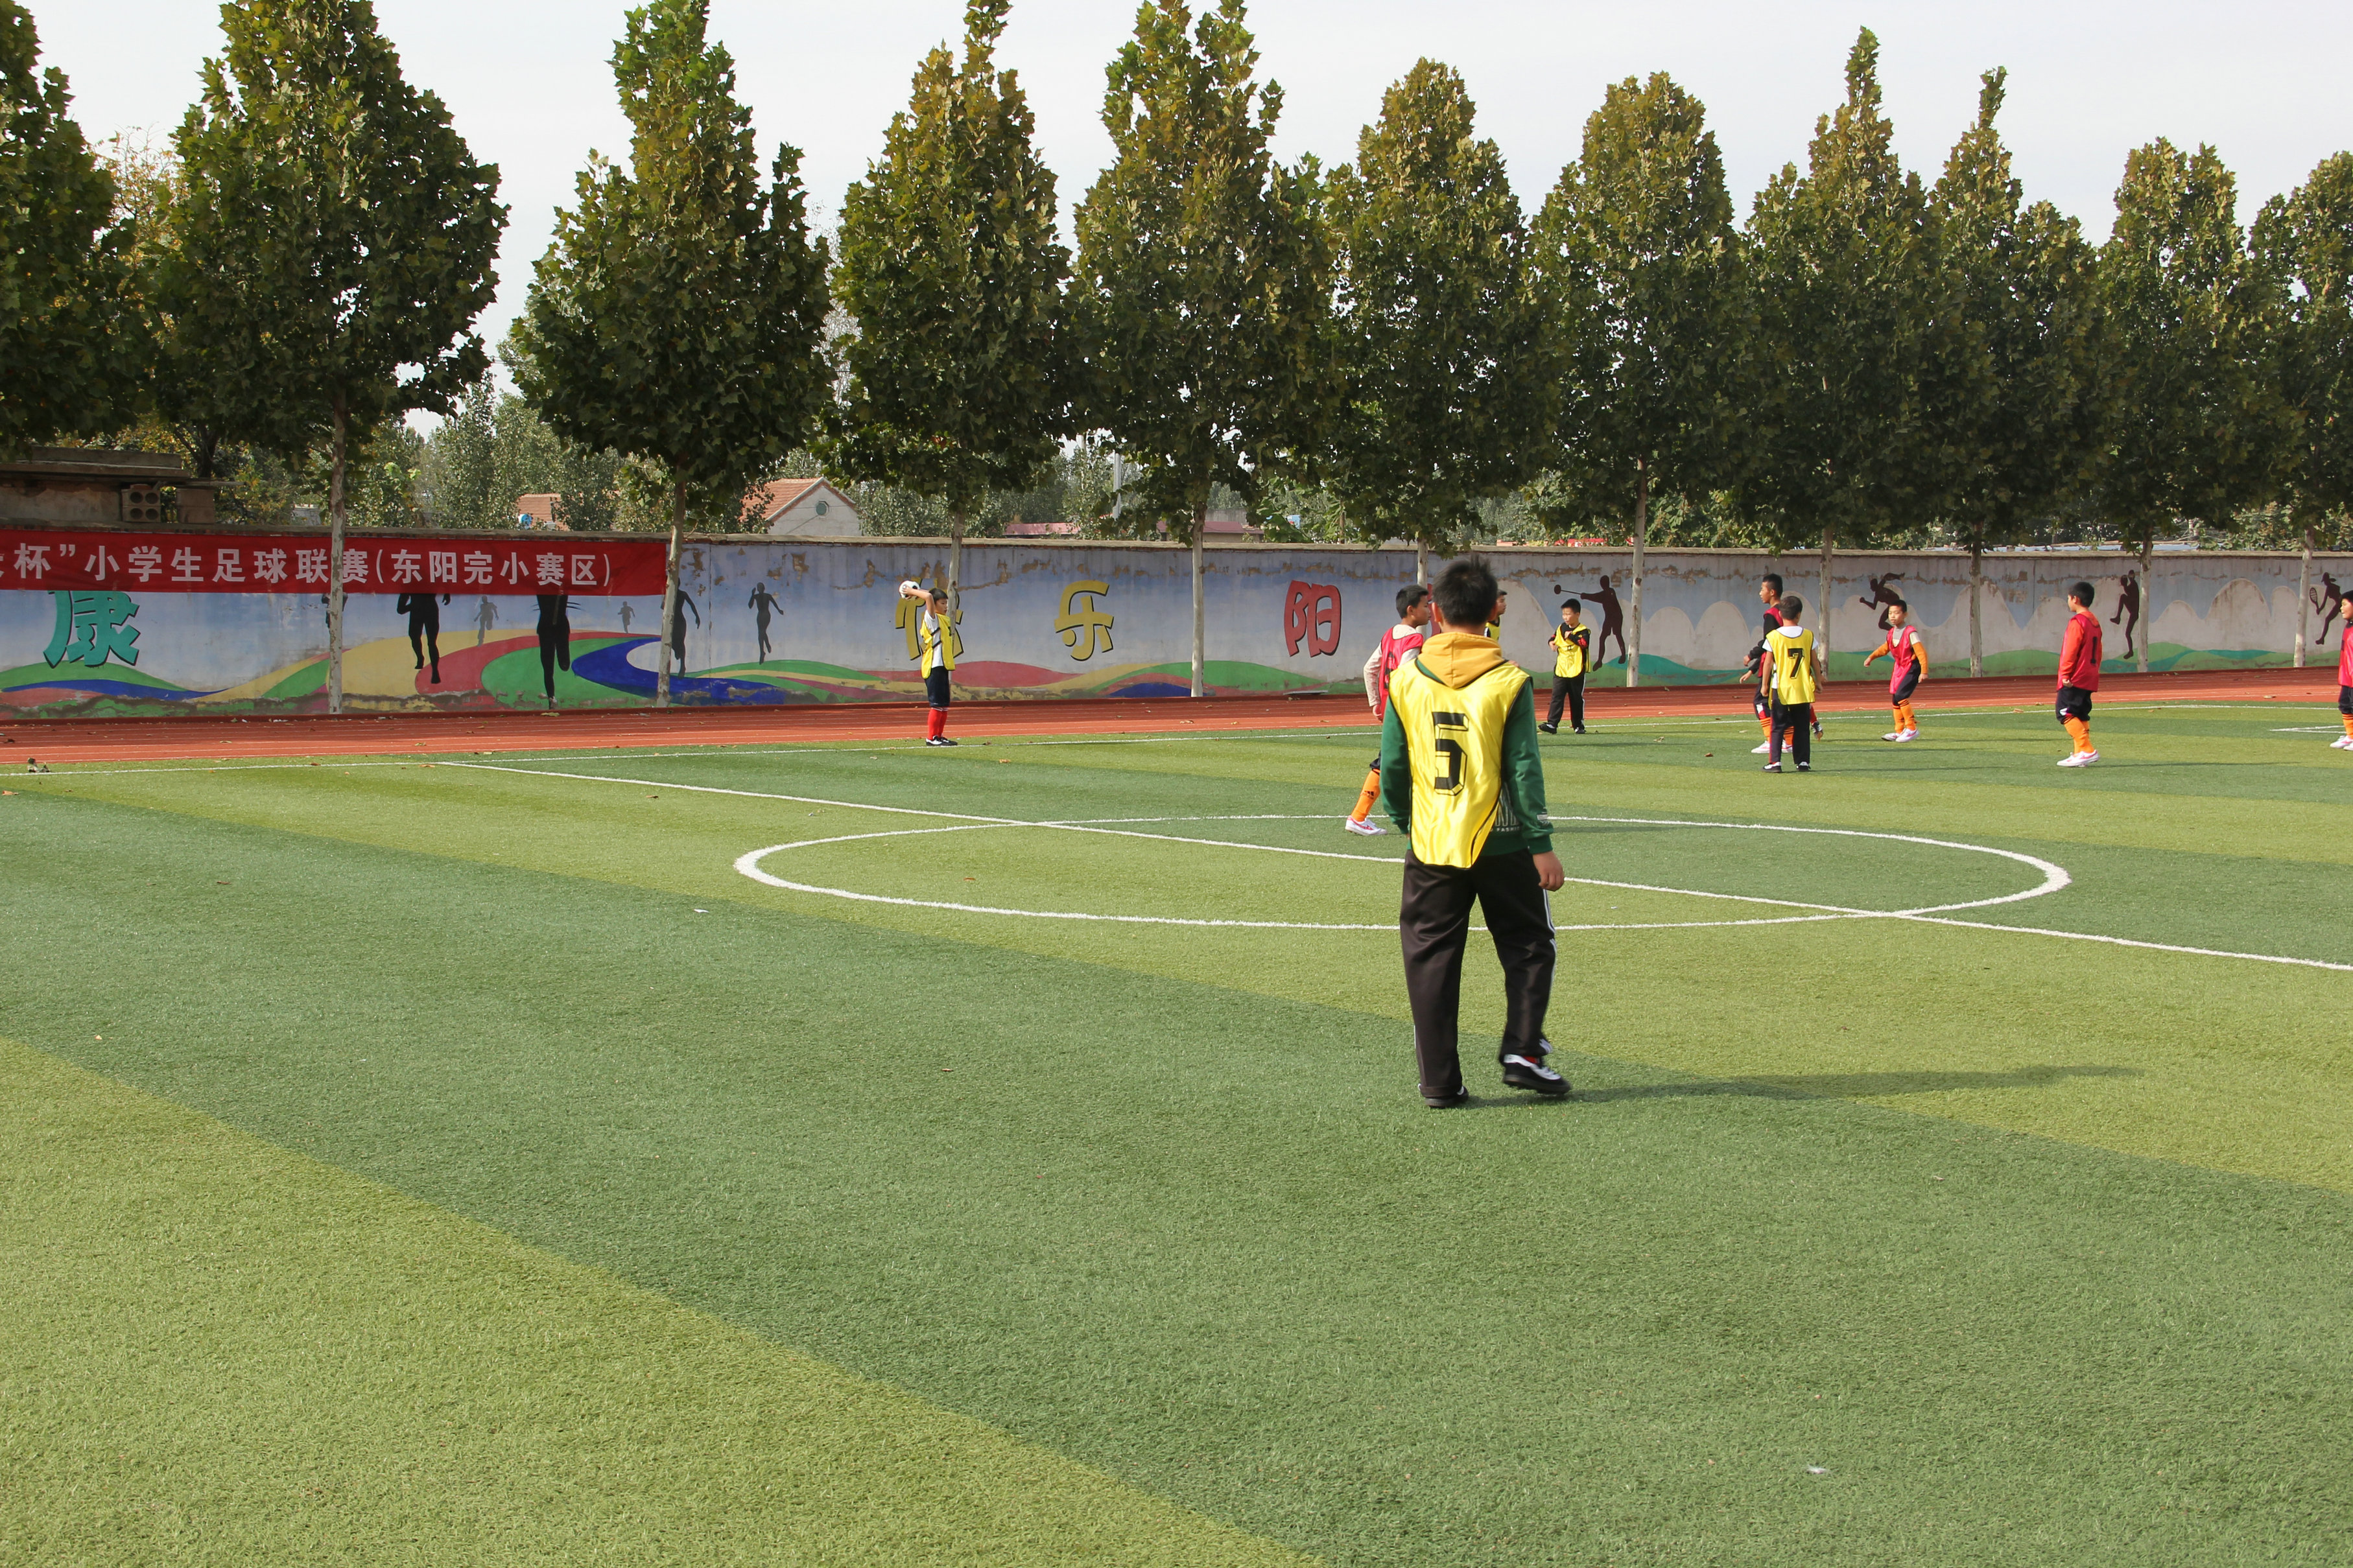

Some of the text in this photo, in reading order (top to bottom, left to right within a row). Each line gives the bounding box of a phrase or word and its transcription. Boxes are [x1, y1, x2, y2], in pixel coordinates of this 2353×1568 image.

[0, 543, 610, 587] 杯”小学生足球联赛(东阳完小赛区)
[43, 591, 140, 668] 康
[1054, 579, 1115, 661] 乐
[1284, 579, 1342, 657] 阳
[1788, 648, 1804, 679] 7
[1432, 712, 1469, 796] 5
